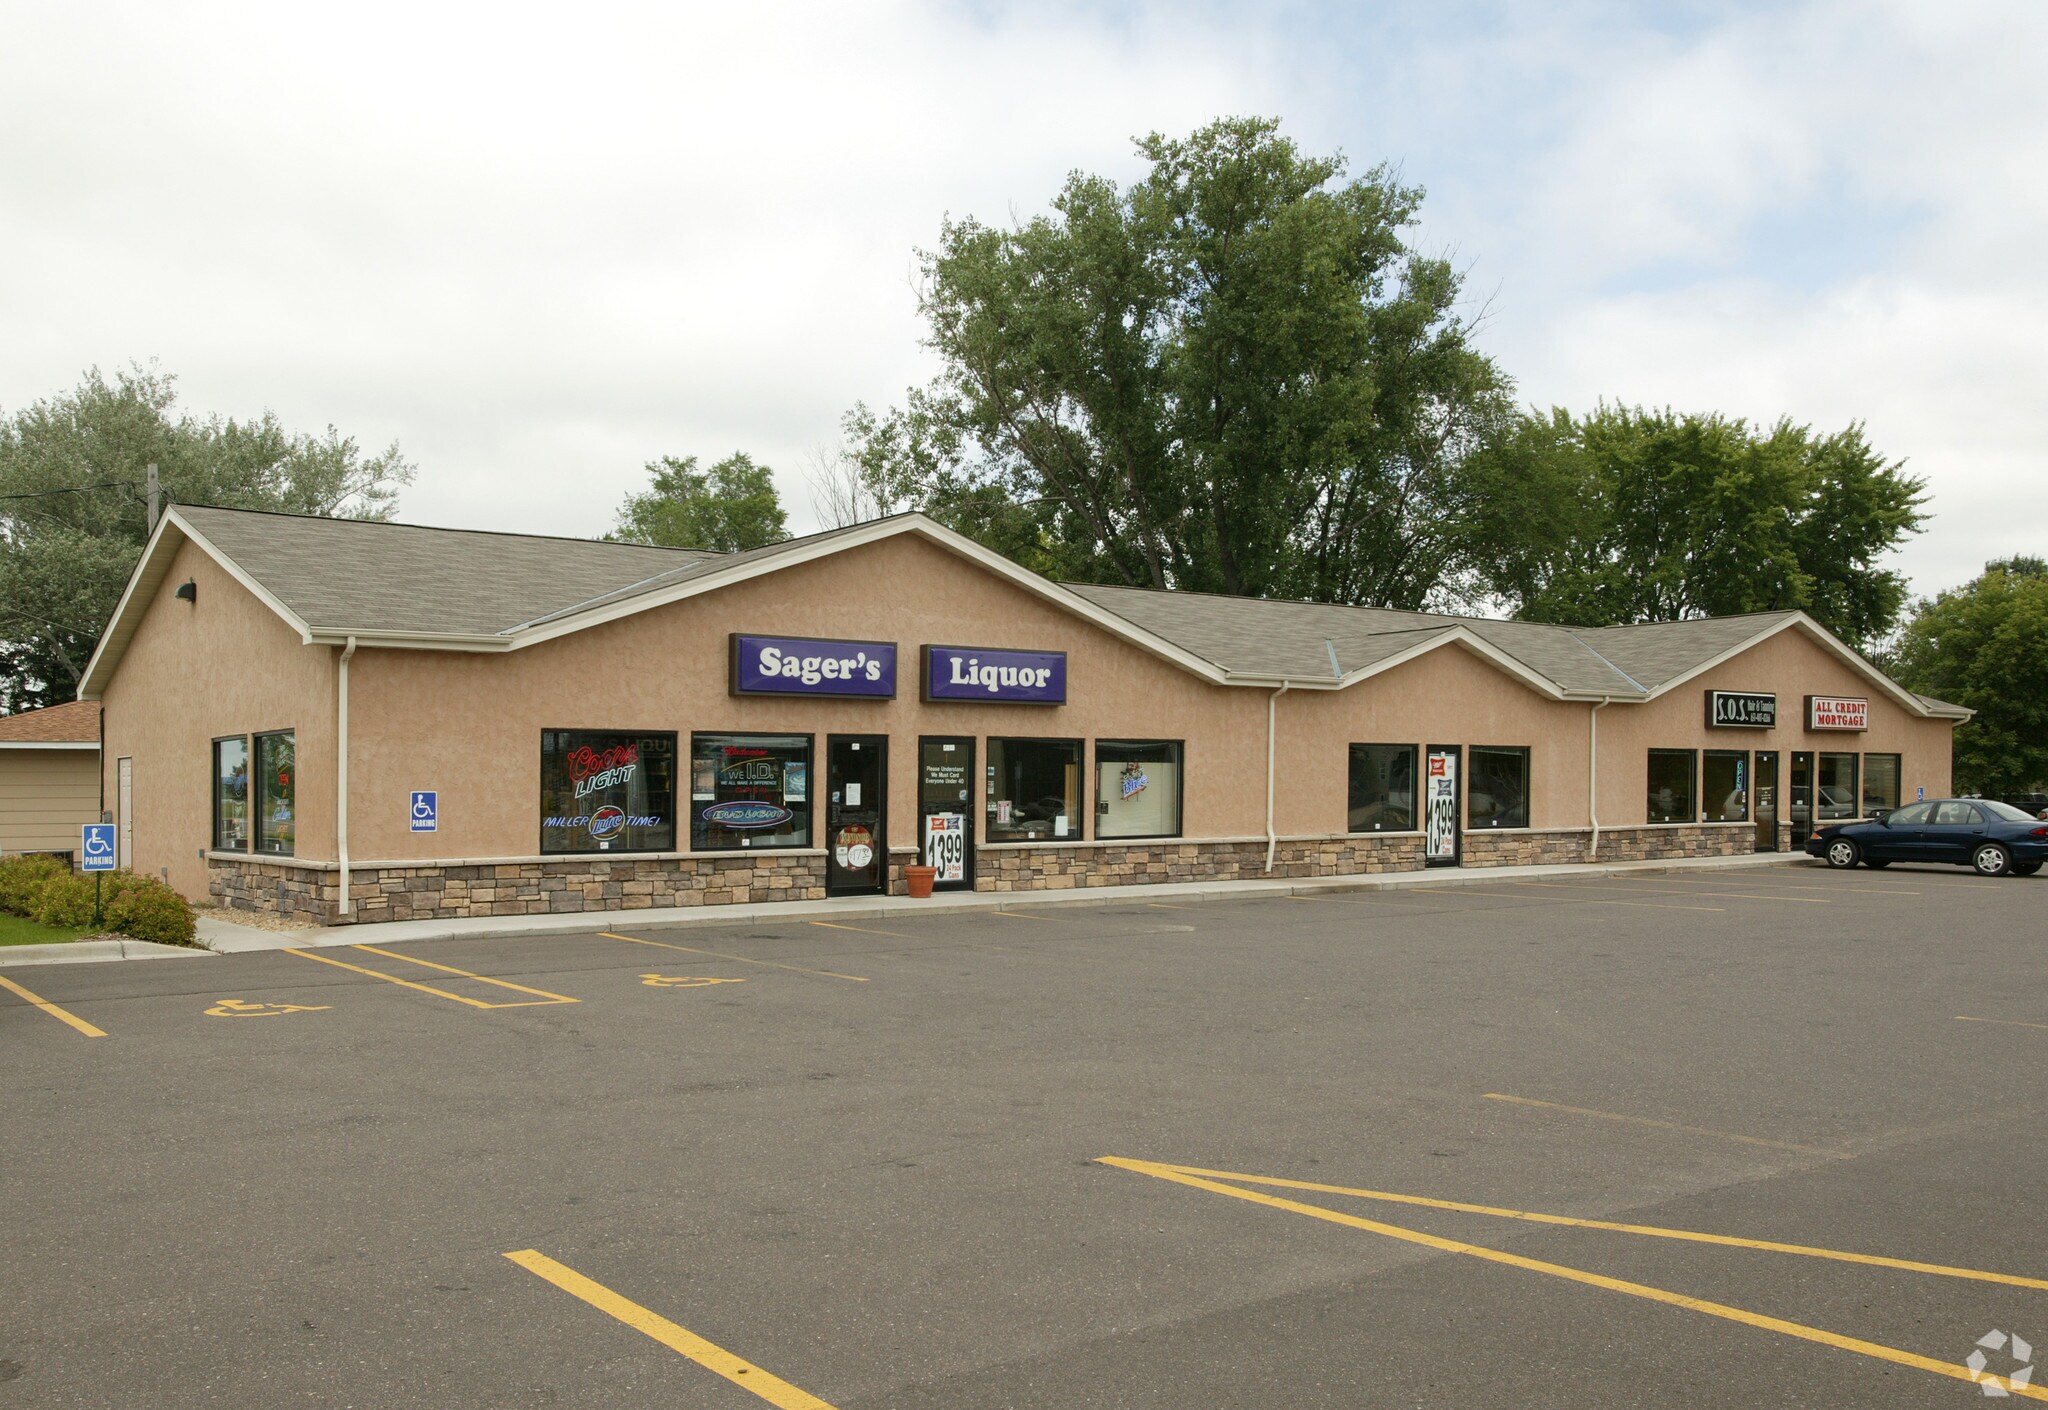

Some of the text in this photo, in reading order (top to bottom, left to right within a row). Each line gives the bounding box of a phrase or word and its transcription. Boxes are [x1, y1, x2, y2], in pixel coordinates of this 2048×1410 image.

[758, 647, 881, 685] Sager's
[950, 657, 1051, 692] Liquor
[1718, 698, 1749, 721] S.O.S.
[1816, 702, 1866, 714] ALL CREDIT
[1817, 714, 1865, 726] MORTGAGE
[567, 744, 639, 782] Coors
[574, 764, 637, 799] LIGHT
[728, 771, 744, 780] WE
[412, 819, 435, 828] PARKING
[542, 816, 590, 827] MILLER
[85, 855, 113, 866] PARKING
